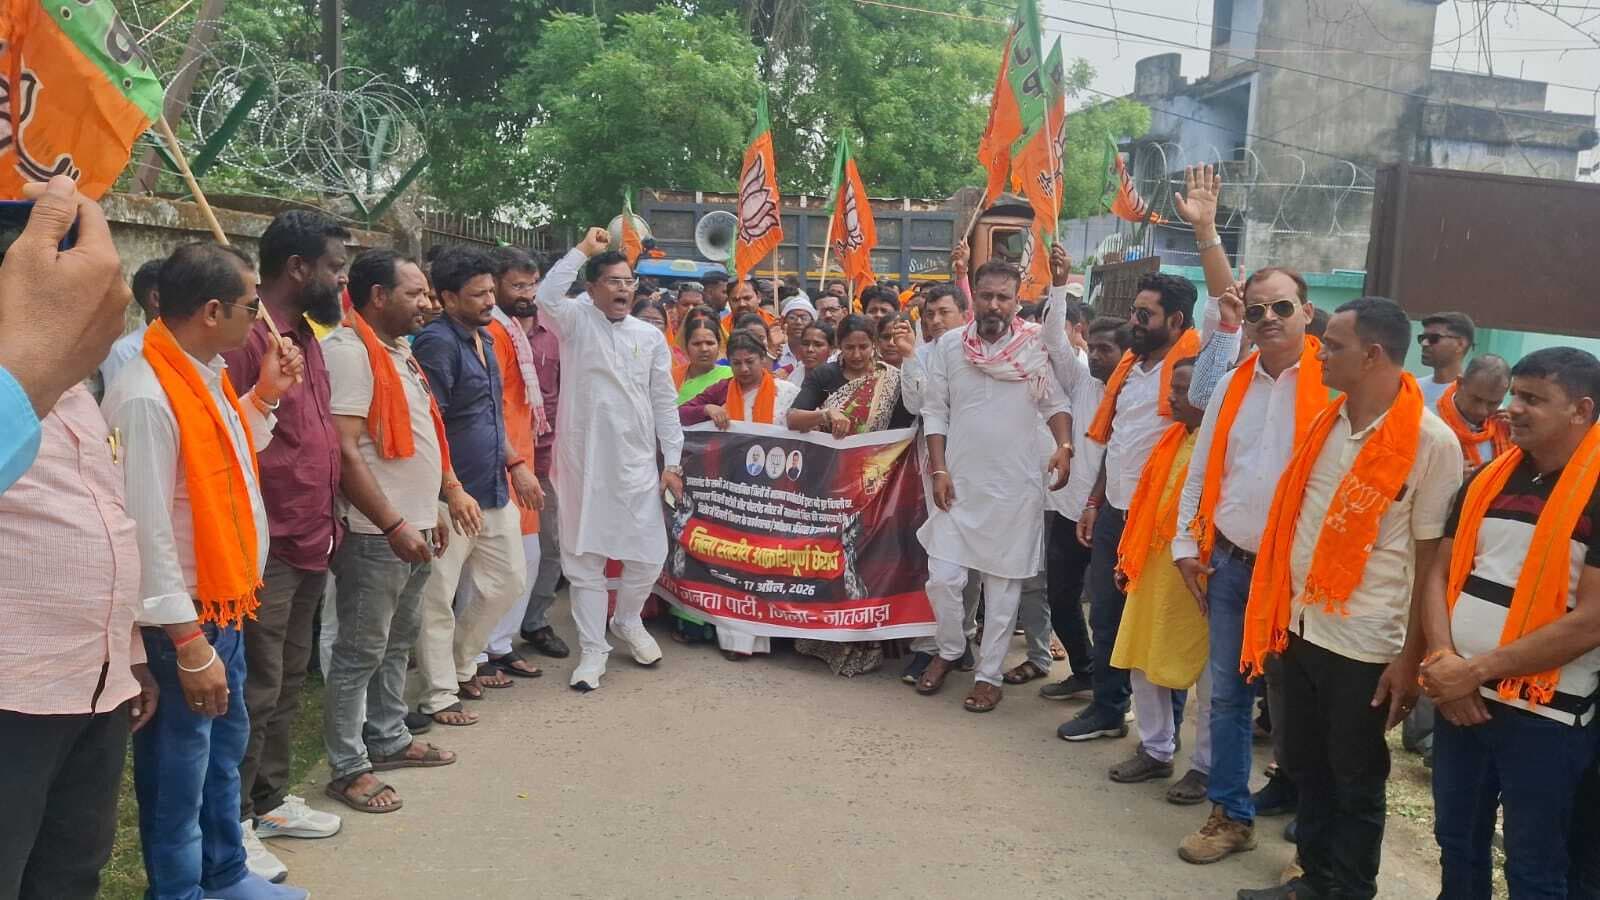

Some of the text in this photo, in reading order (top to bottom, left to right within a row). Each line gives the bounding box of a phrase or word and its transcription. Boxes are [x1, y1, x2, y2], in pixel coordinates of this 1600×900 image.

[689, 526, 717, 557] जिला
[744, 580, 754, 591] 17
[788, 584, 816, 596] 2026
